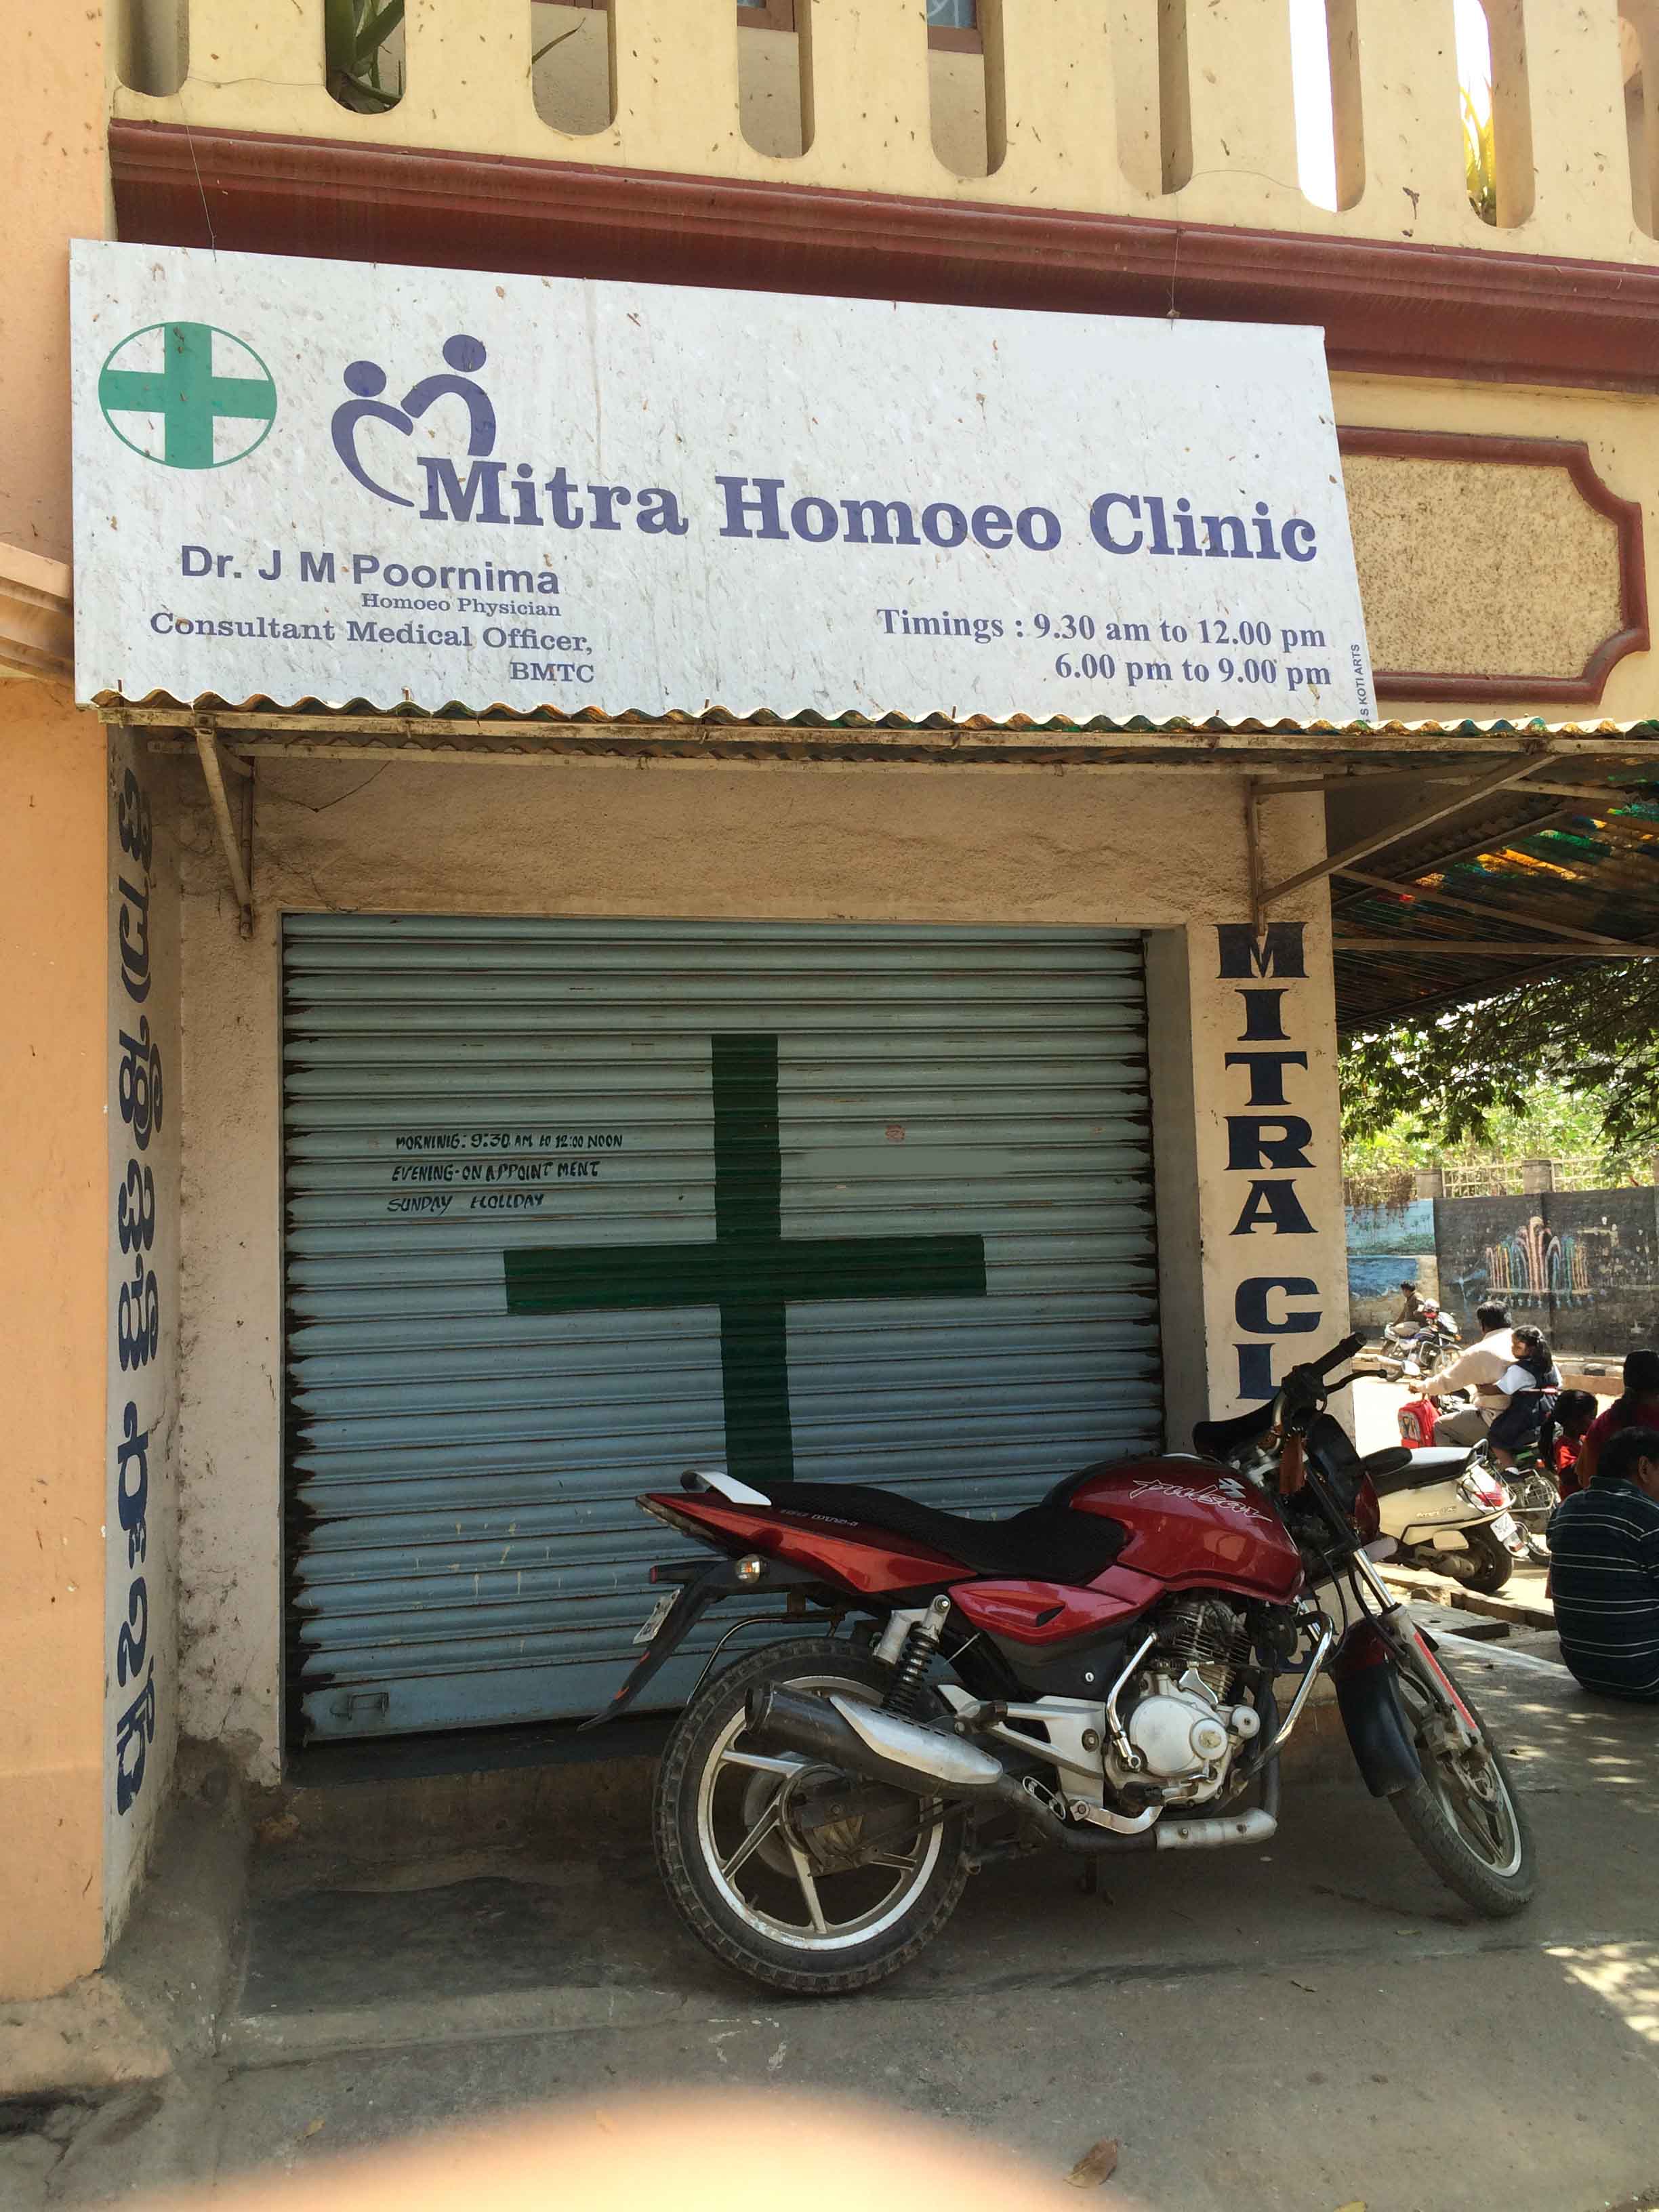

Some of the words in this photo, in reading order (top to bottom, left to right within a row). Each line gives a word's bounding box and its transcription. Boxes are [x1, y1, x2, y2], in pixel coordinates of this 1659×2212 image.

[417, 456, 689, 535] Mitra
[715, 476, 1061, 550] Homoeo
[1090, 493, 1316, 561] Clinic
[182, 546, 241, 578] Dr.
[259, 550, 281, 580] J
[300, 552, 335, 583] M
[352, 554, 560, 594] Poornima
[362, 593, 450, 611] Homoeo
[457, 598, 560, 617] Physician
[150, 613, 335, 640] Consultant
[347, 621, 472, 646] Medical
[483, 628, 592, 655] Officer,
[877, 609, 1003, 643] Timings
[1034, 614, 1094, 640] 9.30
[1106, 623, 1150, 640] am
[1160, 621, 1187, 642] to
[1198, 620, 1271, 645] 12.00
[1282, 630, 1325, 653] pm
[510, 662, 594, 682] BMTC
[1056, 653, 1115, 678] 6.00
[1126, 663, 1172, 686] pm
[1182, 659, 1209, 682] to
[1219, 658, 1276, 683] 9.00
[1286, 668, 1331, 691] pm
[1351, 644, 1364, 675] ARTS
[1355, 678, 1367, 705] KOTI
[1212, 922, 1319, 1235] MITRA
[514, 1134, 533, 1147] AM
[555, 1134, 583, 1149] 12:00
[588, 1134, 623, 1148] NOON
[558, 1161, 600, 1177] MENT
[387, 1195, 453, 1216] SUNDAY
